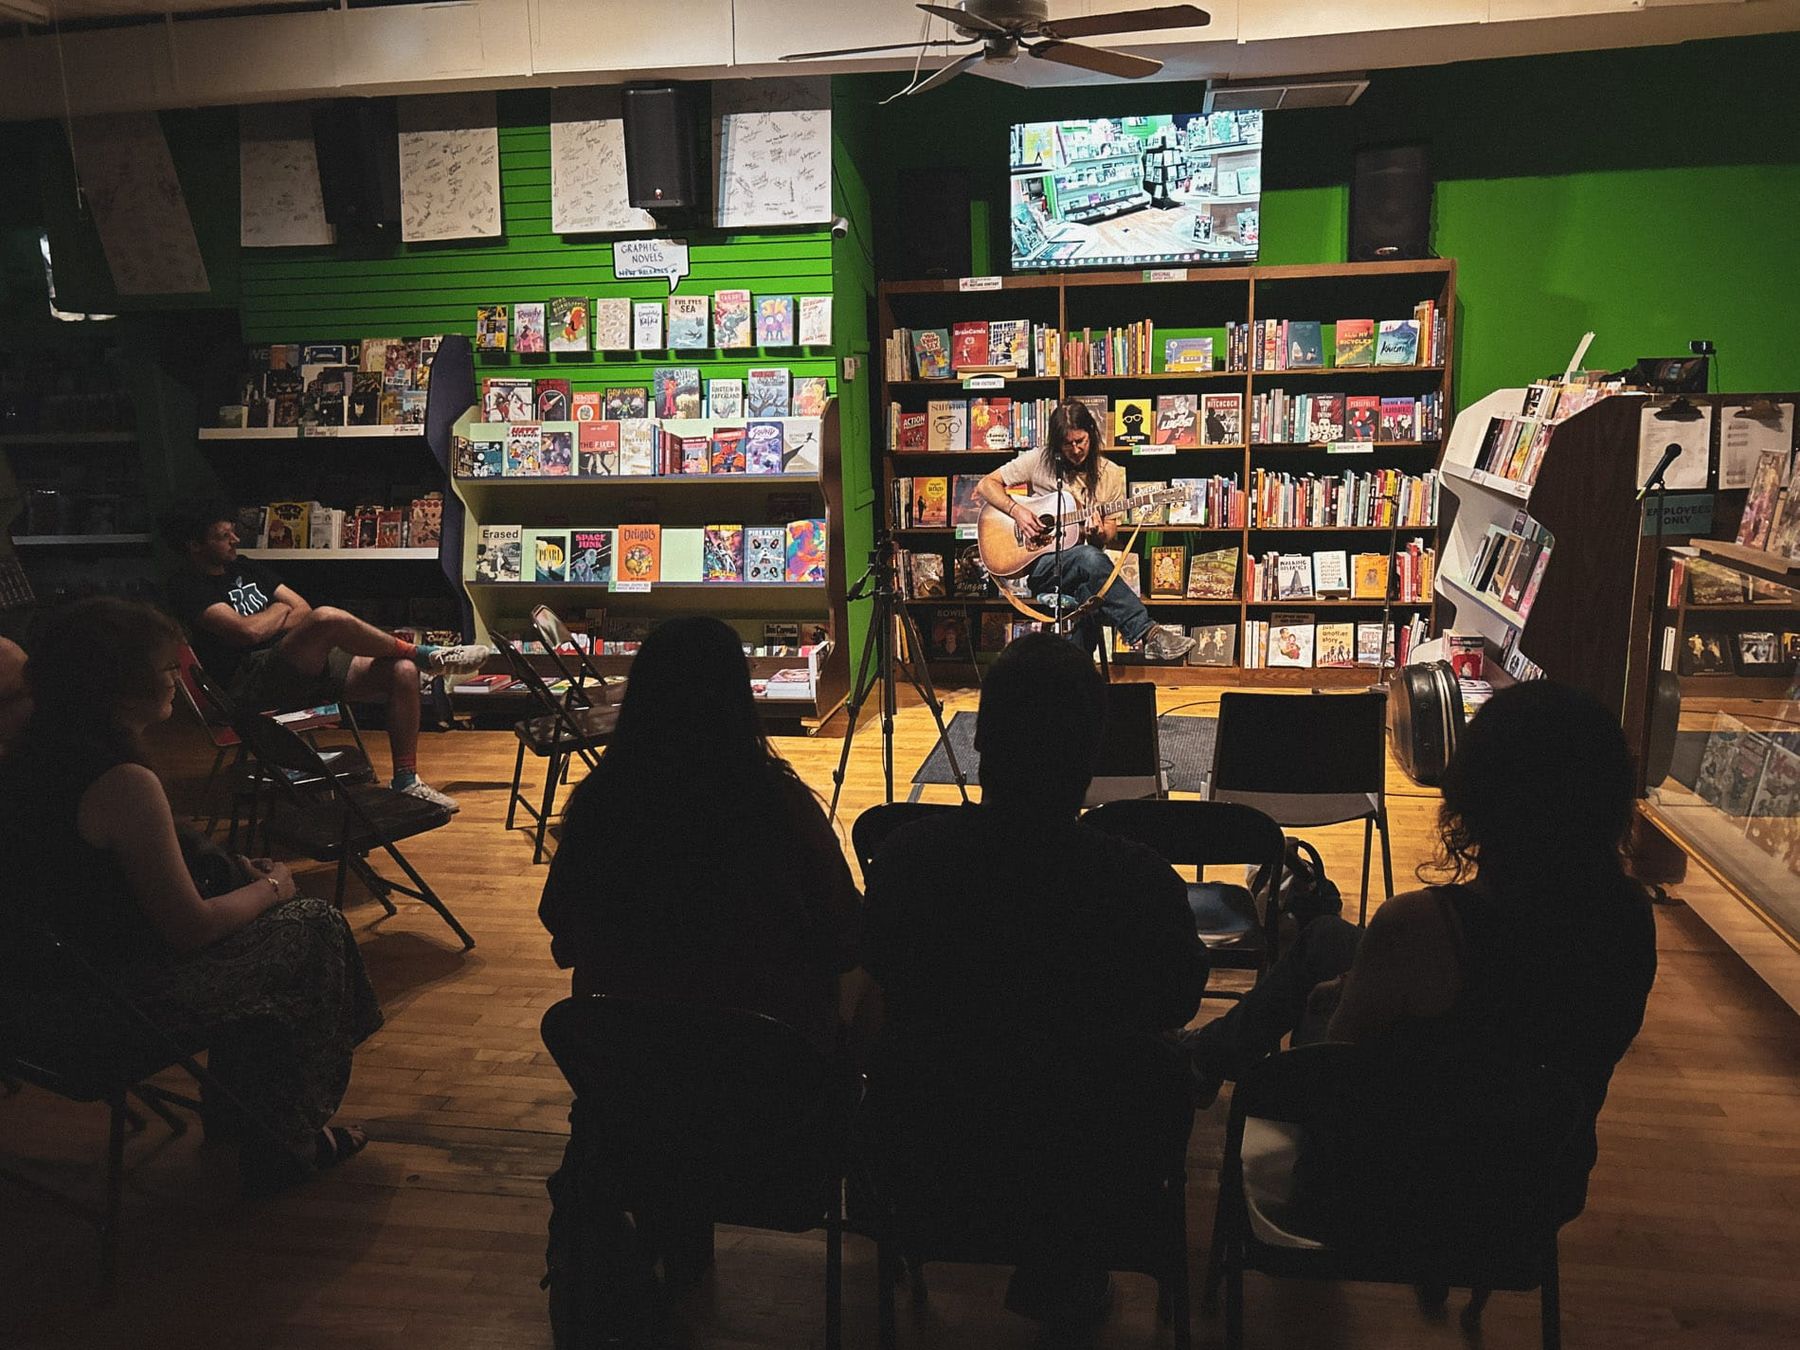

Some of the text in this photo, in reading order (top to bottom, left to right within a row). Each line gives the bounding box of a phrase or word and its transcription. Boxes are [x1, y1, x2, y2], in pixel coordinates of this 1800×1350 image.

[620, 243, 658, 254] GRAPHIC
[632, 252, 664, 264] NOVELS
[680, 305, 696, 313] SEA
[640, 316, 658, 327] Kafka
[903, 414, 925, 426] ACTION
[511, 427, 539, 435] HATE
[579, 440, 616, 448] THE FIXER
[1663, 515, 1693, 525] ONLY
[482, 529, 519, 539] Erased
[576, 534, 606, 542] SPACE
[624, 529, 656, 542] Delights
[578, 541, 603, 549] JUNK
